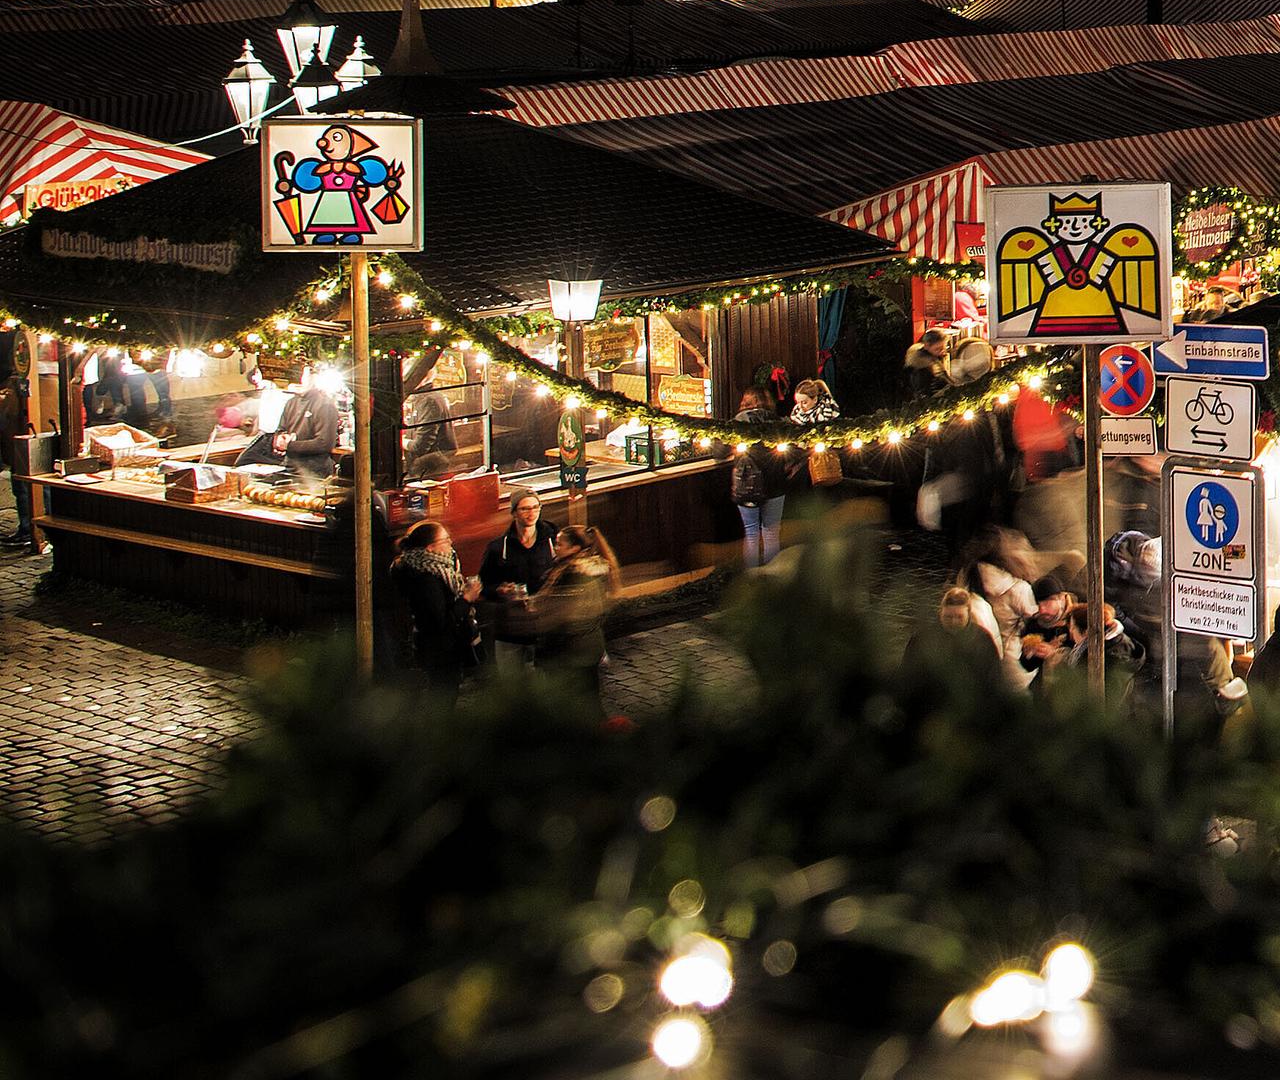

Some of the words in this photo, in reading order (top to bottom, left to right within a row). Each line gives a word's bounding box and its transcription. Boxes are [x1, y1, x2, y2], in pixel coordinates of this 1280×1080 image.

[1185, 212, 1230, 231] Heidelbeer
[1184, 343, 1260, 359] Einbahnstraße
[1101, 431, 1151, 443] ettungsweg
[564, 473, 580, 483] WC
[1192, 551, 1232, 571] ZONE
[1178, 584, 1235, 601] Marktbeschicker
[1236, 594, 1250, 602] zum
[1181, 597, 1246, 616] Christkindlesmarkt
[1226, 620, 1239, 631] frei
